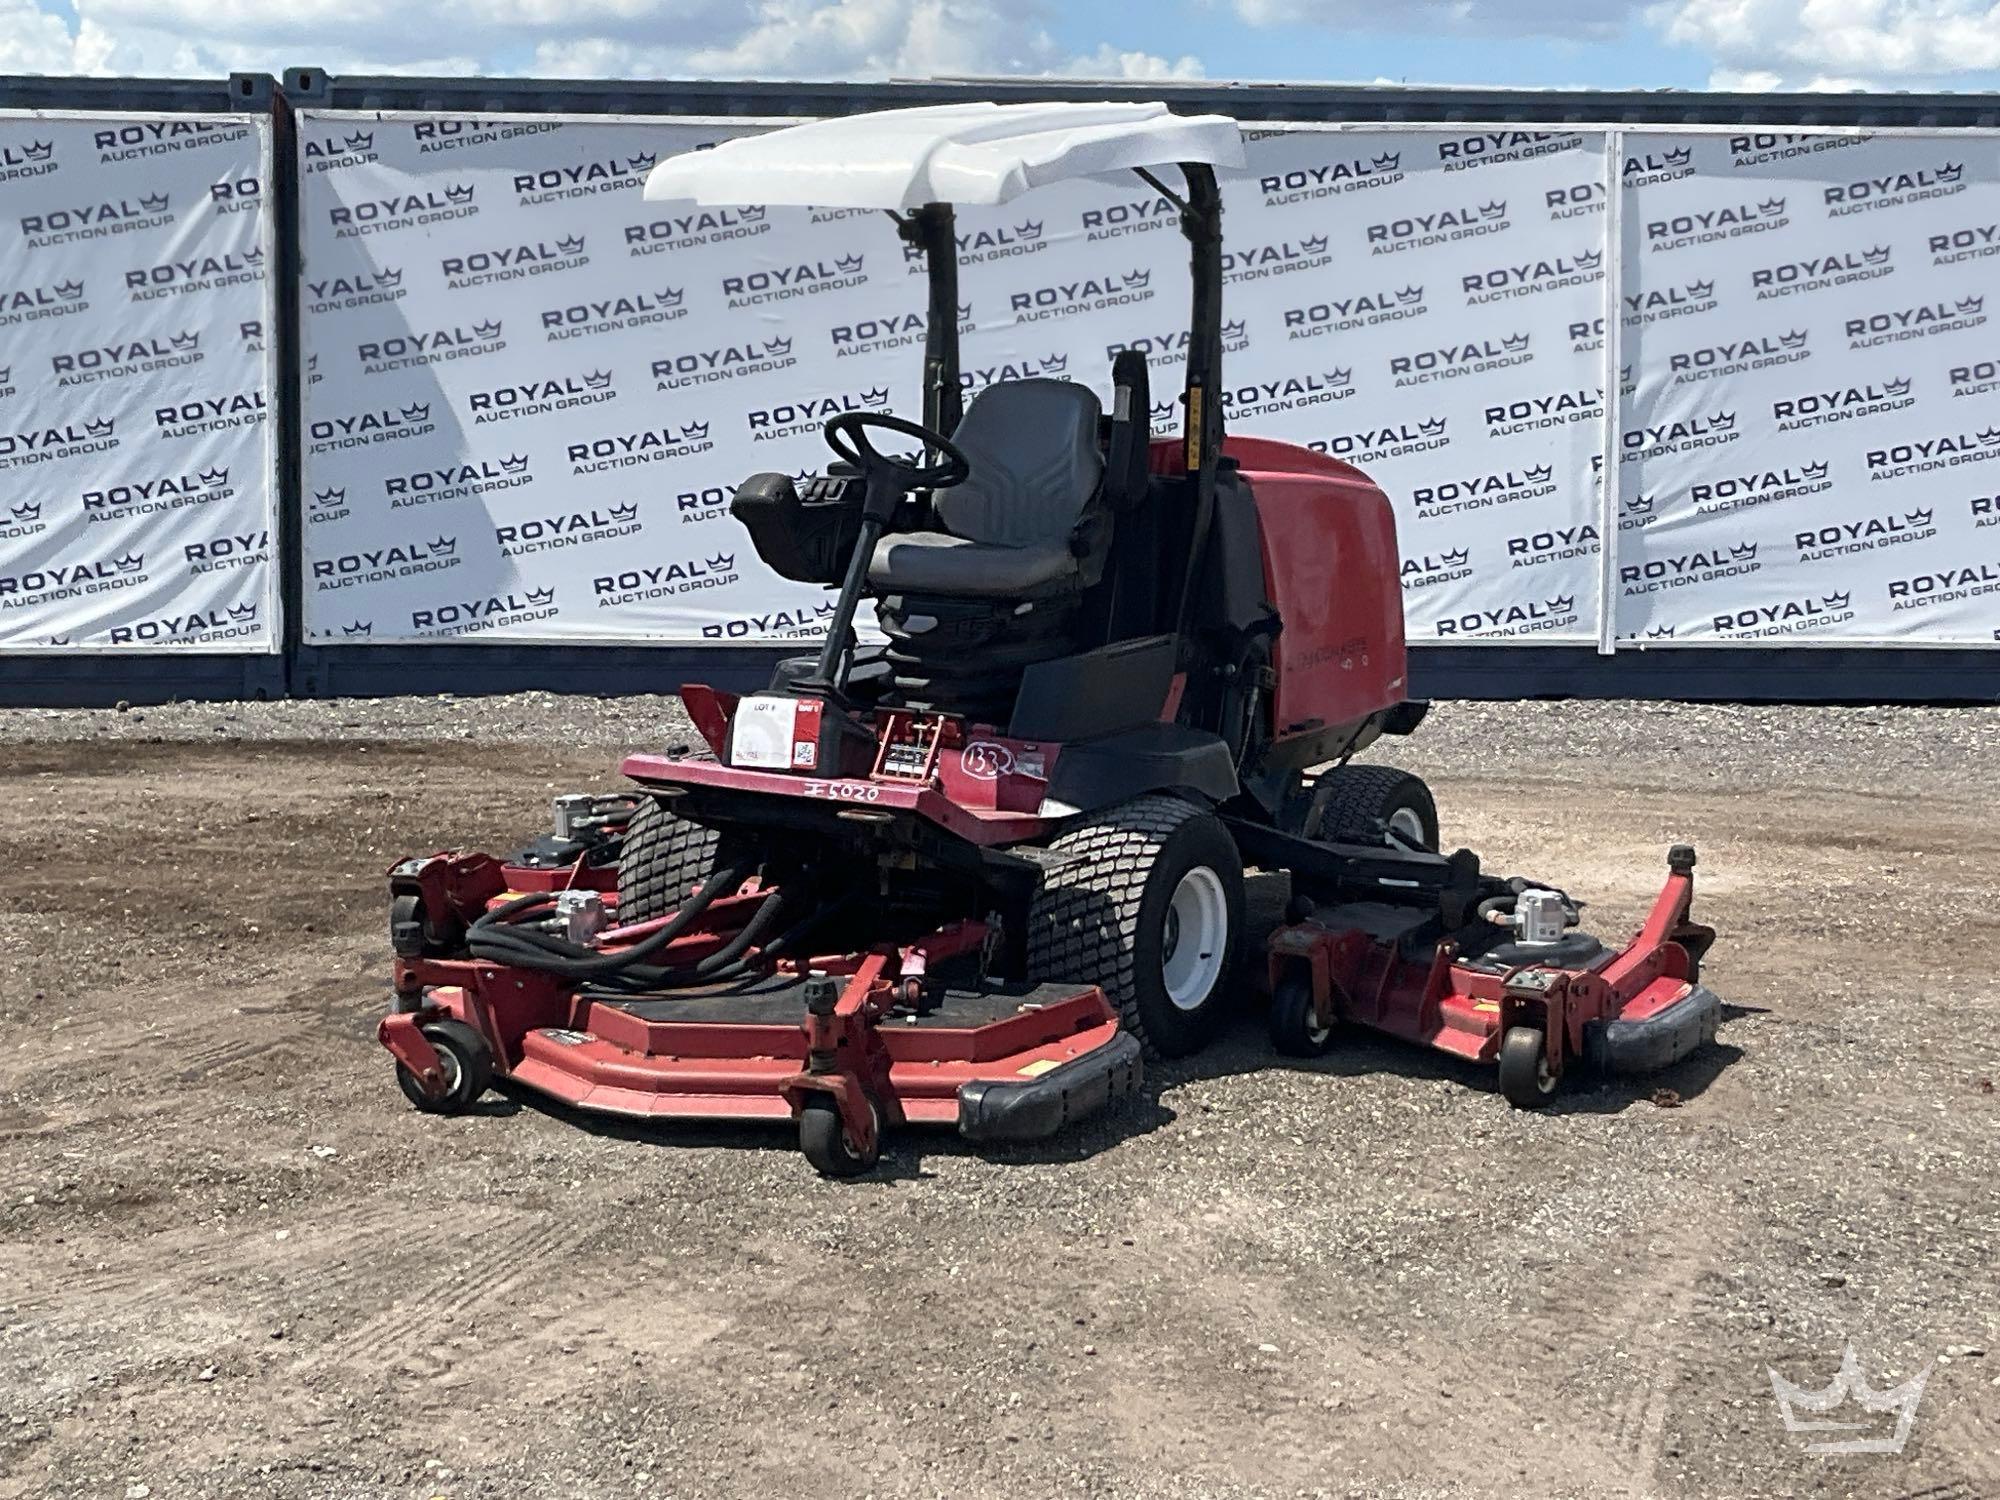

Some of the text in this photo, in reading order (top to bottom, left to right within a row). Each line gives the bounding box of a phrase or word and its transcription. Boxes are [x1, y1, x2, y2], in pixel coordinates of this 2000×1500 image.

[100, 130, 247, 164] AUCTION GROUP
[419, 132, 496, 153] AUCTION
[1443, 138, 1582, 172] AUCTION GROUP
[1735, 146, 1810, 168] AUCTION
[316, 153, 378, 171] GROUP
[514, 160, 628, 194] ROYAL
[1261, 161, 1372, 195] ROYAL
[1636, 168, 1695, 187] GROUP
[519, 184, 596, 206] AUCTION
[1265, 173, 1404, 207] AUCTION GROUP
[1824, 171, 1935, 206] ROYAL
[1828, 184, 1966, 218] AUCTION GROUP
[21, 201, 140, 236] ROYAL
[330, 193, 446, 226] ROYAL
[336, 206, 479, 239] AUCTION GROUP
[1367, 209, 1479, 244] ROYAL
[1648, 206, 1758, 240] ROYAL
[27, 215, 174, 248] AUCTION GROUP
[625, 211, 738, 245] ROYAL
[630, 224, 770, 257] AUCTION GROUP
[1086, 220, 1162, 242] AUCTION
[1372, 221, 1510, 256] AUCTION GROUP
[1652, 218, 1789, 252] AUCTION GROUP
[442, 243, 557, 277] ROYAL
[988, 241, 1047, 260] GROUP
[1273, 256, 1332, 274] GROUP
[125, 255, 244, 290] ROYAL
[448, 257, 589, 290] AUCTION GROUP
[723, 262, 836, 297] ROYAL
[1462, 259, 1574, 294] ROYAL
[1752, 254, 1863, 288] ROYAL
[1756, 266, 1894, 300] AUCTION GROUP
[131, 279, 211, 302] AUCTION
[346, 290, 406, 308] GROUP
[728, 275, 868, 309] AUCTION GROUP
[1011, 278, 1123, 312] ROYAL
[1467, 271, 1605, 306] AUCTION GROUP
[26, 302, 89, 320] GROUP
[542, 296, 656, 329] ROYAL
[1016, 290, 1154, 324] AUCTION GROUP
[1284, 294, 1396, 328] ROYAL
[1289, 306, 1427, 340] AUCTION GROUP
[1659, 300, 1718, 319] GROUP
[1845, 304, 1956, 338] ROYAL
[547, 309, 688, 341] AUCTION GROUP
[1850, 316, 1986, 350] AUCTION GROUP
[52, 340, 171, 374] ROYAL
[359, 328, 474, 362] ROYAL
[364, 342, 506, 374] AUCTION GROUP
[652, 345, 764, 379] ROYAL
[836, 335, 912, 358] AUCTION
[1390, 341, 1502, 376] ROYAL
[1670, 338, 1780, 373] ROYAL
[58, 353, 204, 387] AUCTION GROUP
[656, 358, 796, 391] AUCTION GROUP
[1395, 354, 1533, 388] AUCTION GROUP
[1674, 350, 1810, 384] AUCTION GROUP
[470, 378, 584, 412] ROYAL
[475, 391, 616, 424] AUCTION GROUP
[1296, 388, 1355, 406] GROUP
[1485, 391, 1597, 426] ROYAL
[1774, 386, 1884, 420] ROYAL
[161, 418, 240, 440] AUCTION
[749, 396, 861, 430] ROYAL
[1489, 415, 1565, 437] AUCTION
[1778, 398, 1914, 432] AUCTION GROUP
[57, 439, 119, 458] GROUP
[373, 424, 434, 442] GROUP
[568, 429, 682, 463] ROYAL
[1391, 438, 1450, 456] GROUP
[1681, 432, 1739, 450] GROUP
[573, 442, 713, 475] AUCTION GROUP
[1867, 435, 1976, 469] ROYAL
[386, 462, 500, 497] ROYAL
[1692, 469, 1801, 504] ROYAL
[1871, 459, 1945, 481] AUCTION
[83, 476, 200, 511] ROYAL
[88, 489, 233, 523] AUCTION GROUP
[391, 475, 533, 509] AUCTION GROUP
[1413, 473, 1525, 507] ROYAL
[1418, 485, 1556, 519] AUCTION GROUP
[1696, 482, 1832, 516] AUCTION GROUP
[496, 511, 610, 545] ROYAL
[501, 524, 642, 557] AUCTION GROUP
[1796, 516, 1905, 551] ROYAL
[1800, 528, 1936, 562] AUCTION GROUP
[313, 545, 428, 579] ROYAL
[318, 557, 460, 591] AUCTION GROUP
[1512, 546, 1587, 568] AUCTION
[1620, 551, 1730, 584] ROYAL
[0, 562, 115, 597] ROYAL
[2, 575, 148, 609] AUCTION GROUP
[594, 562, 707, 596] ROYAL
[599, 574, 738, 607] AUCTION GROUP
[1414, 568, 1473, 586] GROUP
[1624, 562, 1761, 596] AUCTION GROUP
[1889, 565, 1998, 599] ROYAL
[412, 596, 526, 629] ROYAL
[498, 608, 558, 625] GROUP
[1713, 600, 1823, 633] ROYAL
[1893, 589, 1967, 611] AUCTION
[111, 611, 228, 645] ROYAL
[200, 623, 261, 642] GROUP
[1436, 603, 1548, 637] ROYAL
[1519, 615, 1578, 633] GROUP
[1796, 612, 1854, 629] GROUP
